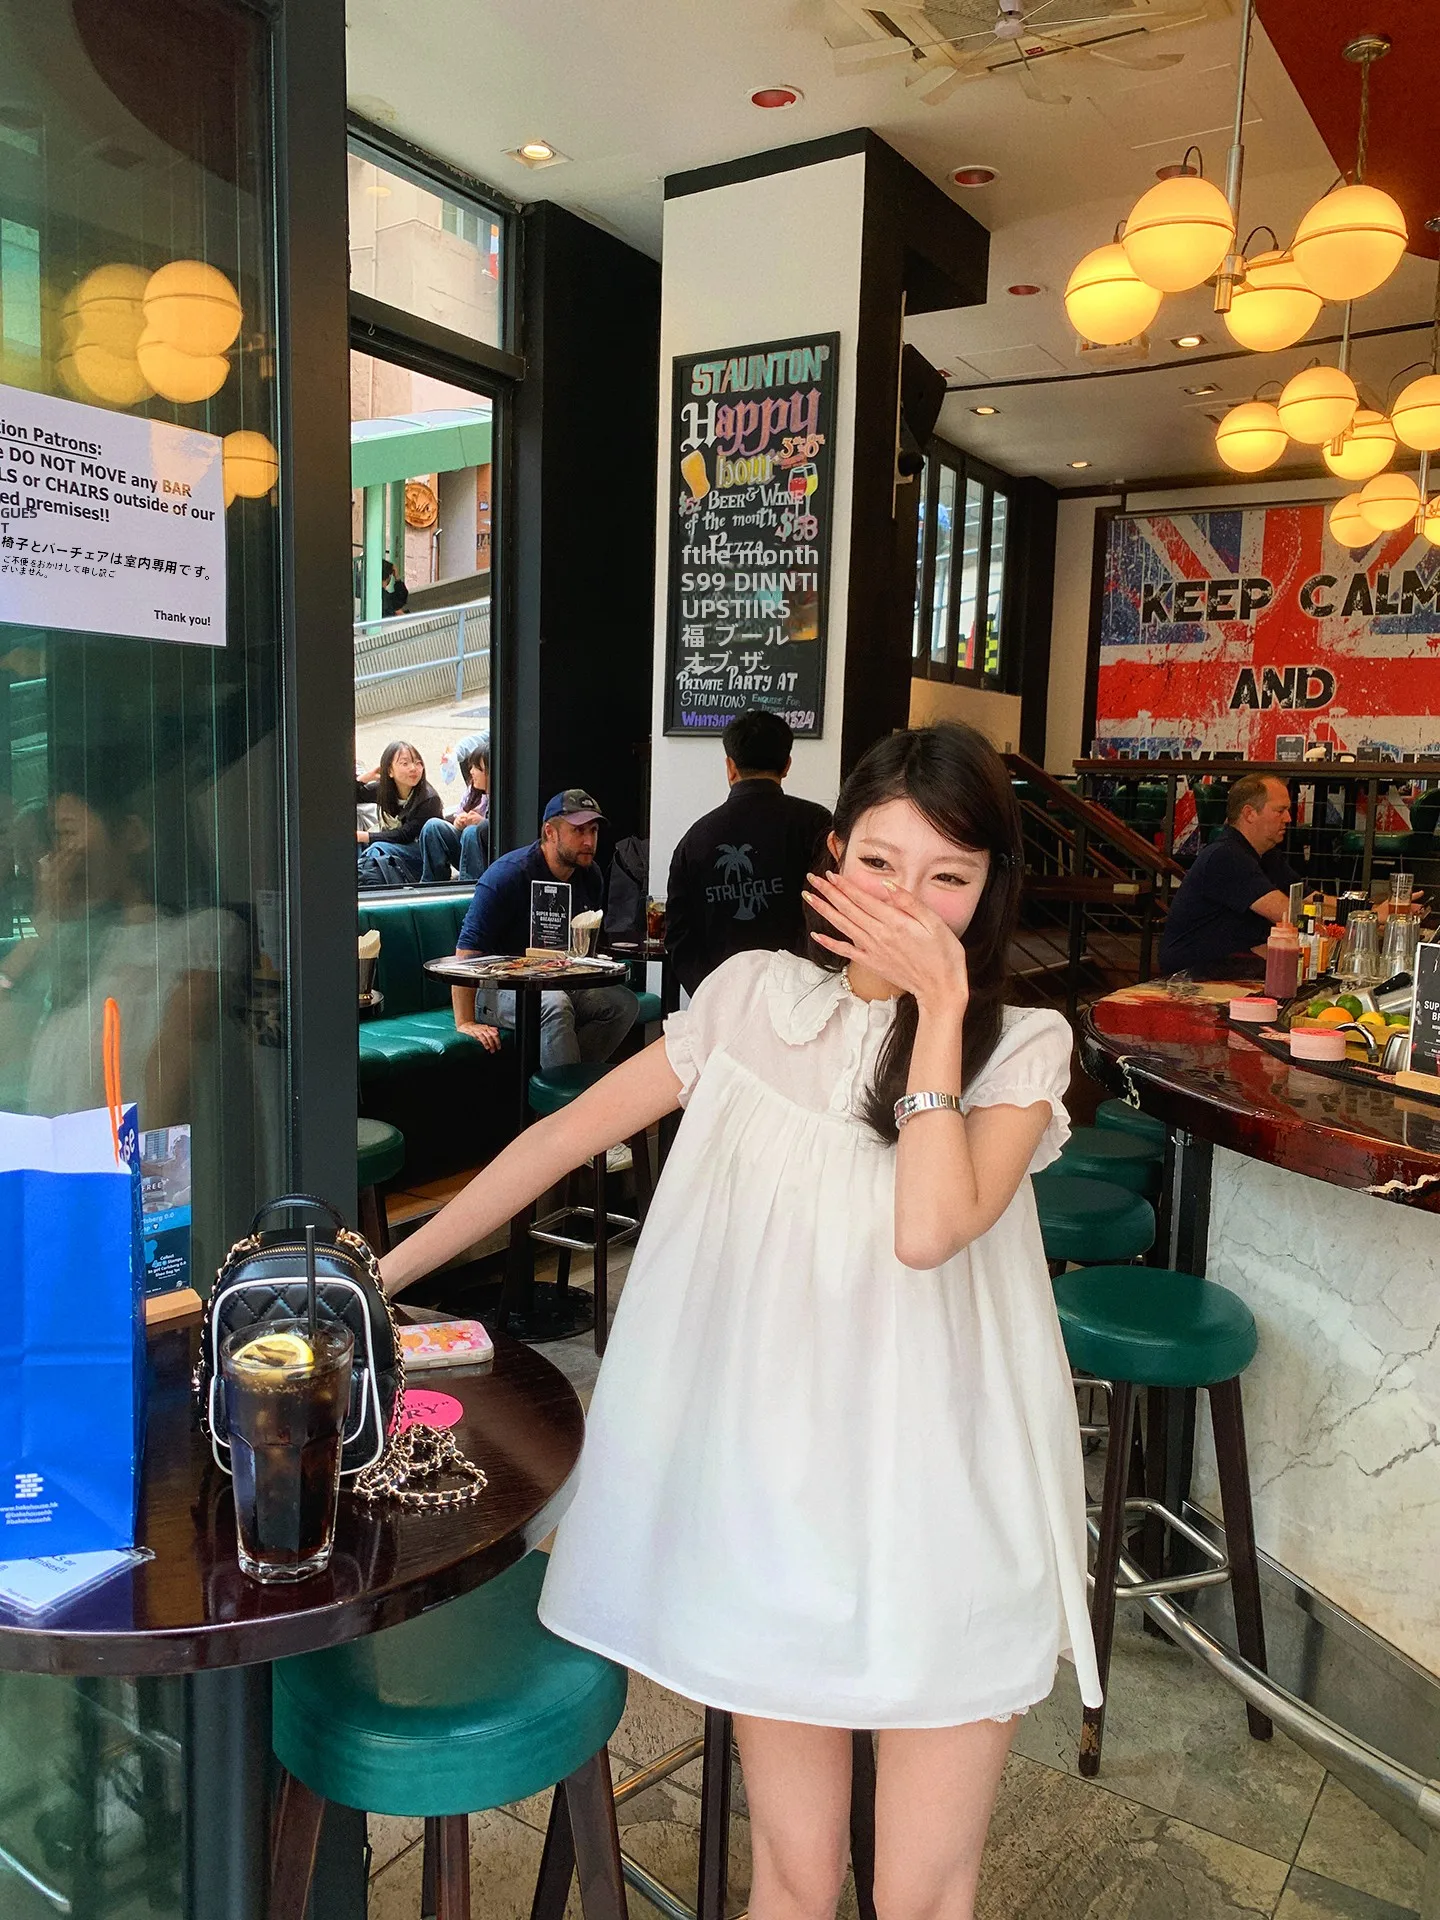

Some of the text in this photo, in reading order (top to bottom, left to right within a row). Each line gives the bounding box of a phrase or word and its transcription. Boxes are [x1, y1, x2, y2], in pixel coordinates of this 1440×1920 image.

[0, 419, 28, 439] ion
[33, 427, 102, 456] Patrons:
[680, 387, 822, 457] Happy
[9, 446, 35, 465] DO
[40, 453, 76, 474] NOT
[80, 461, 127, 485] MOVE
[130, 474, 158, 493] any
[162, 479, 192, 498] BAR
[0, 491, 110, 523] ed premises!!
[22, 474, 41, 488] or
[45, 476, 109, 502] CHAIRS
[113, 490, 169, 513] outside
[173, 502, 188, 516] of
[190, 507, 216, 522] our
[745, 486, 760, 502] &
[701, 510, 726, 531] the
[732, 507, 778, 529] month
[1141, 569, 1440, 624] KEEP CALM
[153, 609, 211, 627] Thank you!
[776, 672, 799, 692] AT
[1229, 666, 1336, 711] AND
[705, 877, 784, 903] STRUGGLE
[1424, 1000, 1440, 1012] SUP
